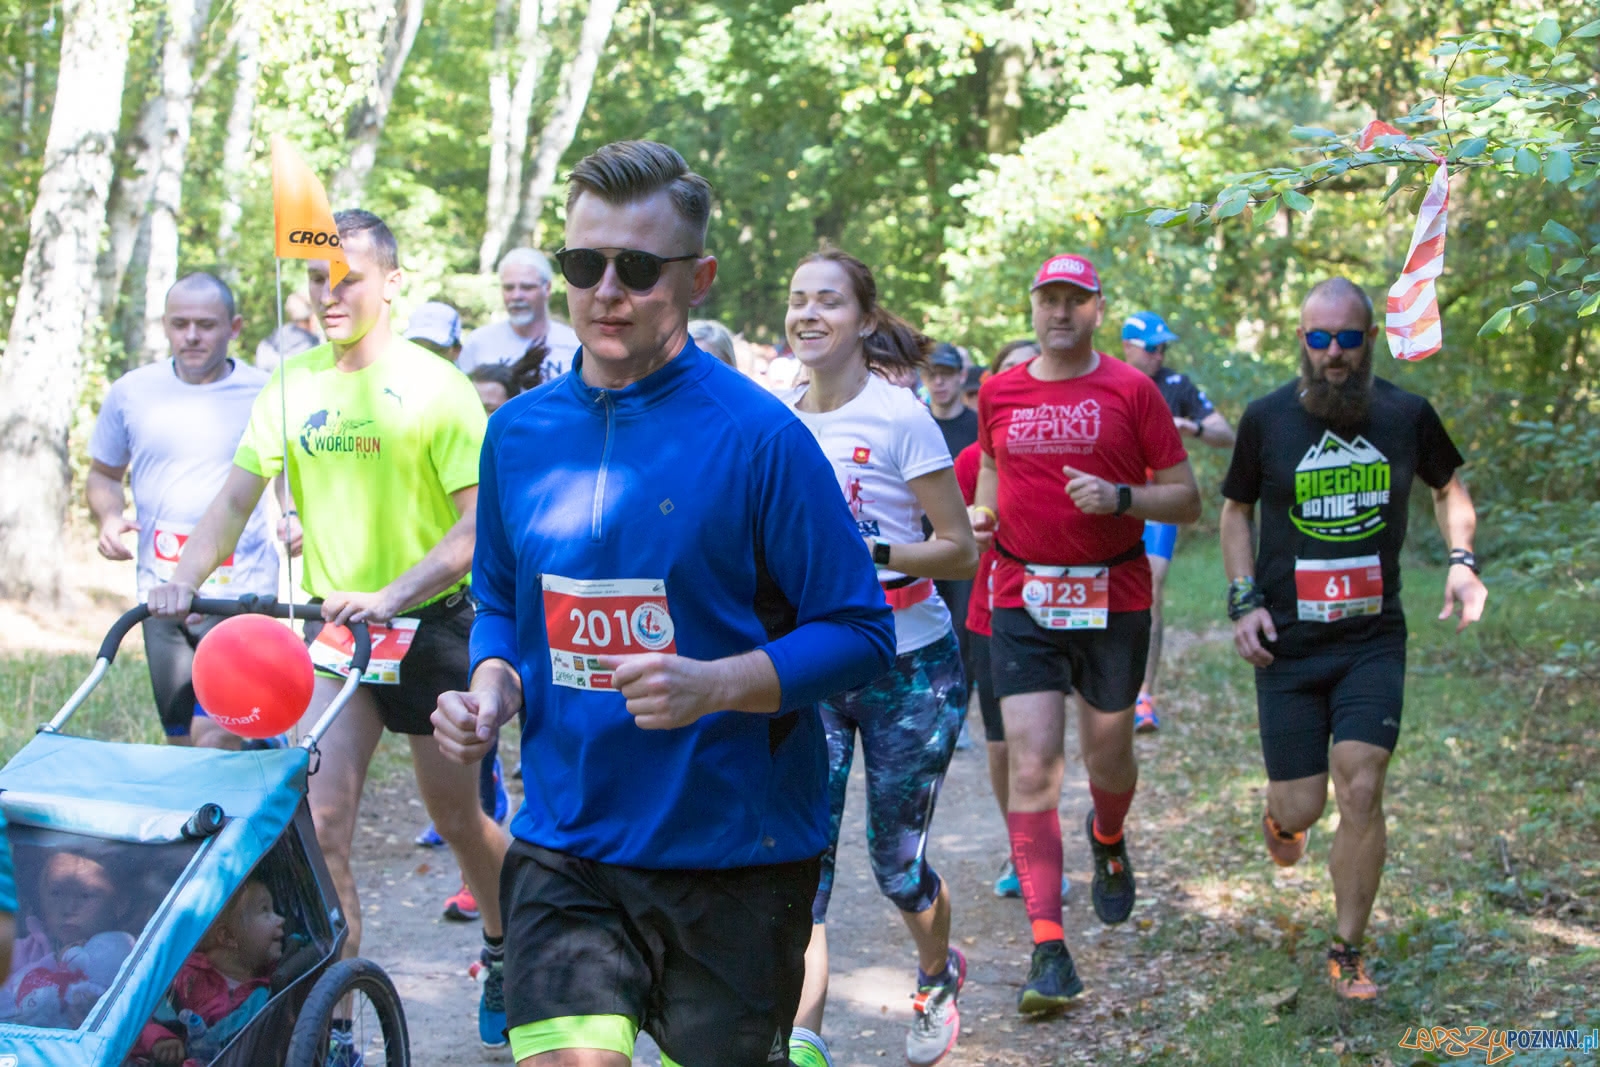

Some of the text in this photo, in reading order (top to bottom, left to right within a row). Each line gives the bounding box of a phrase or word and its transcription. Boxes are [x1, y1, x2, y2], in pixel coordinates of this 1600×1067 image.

[289, 230, 344, 248] CROO
[1008, 417, 1101, 441] SZPIKU
[1295, 461, 1391, 505] BIEGAM
[1046, 583, 1087, 605] 123
[1325, 575, 1351, 598] 61
